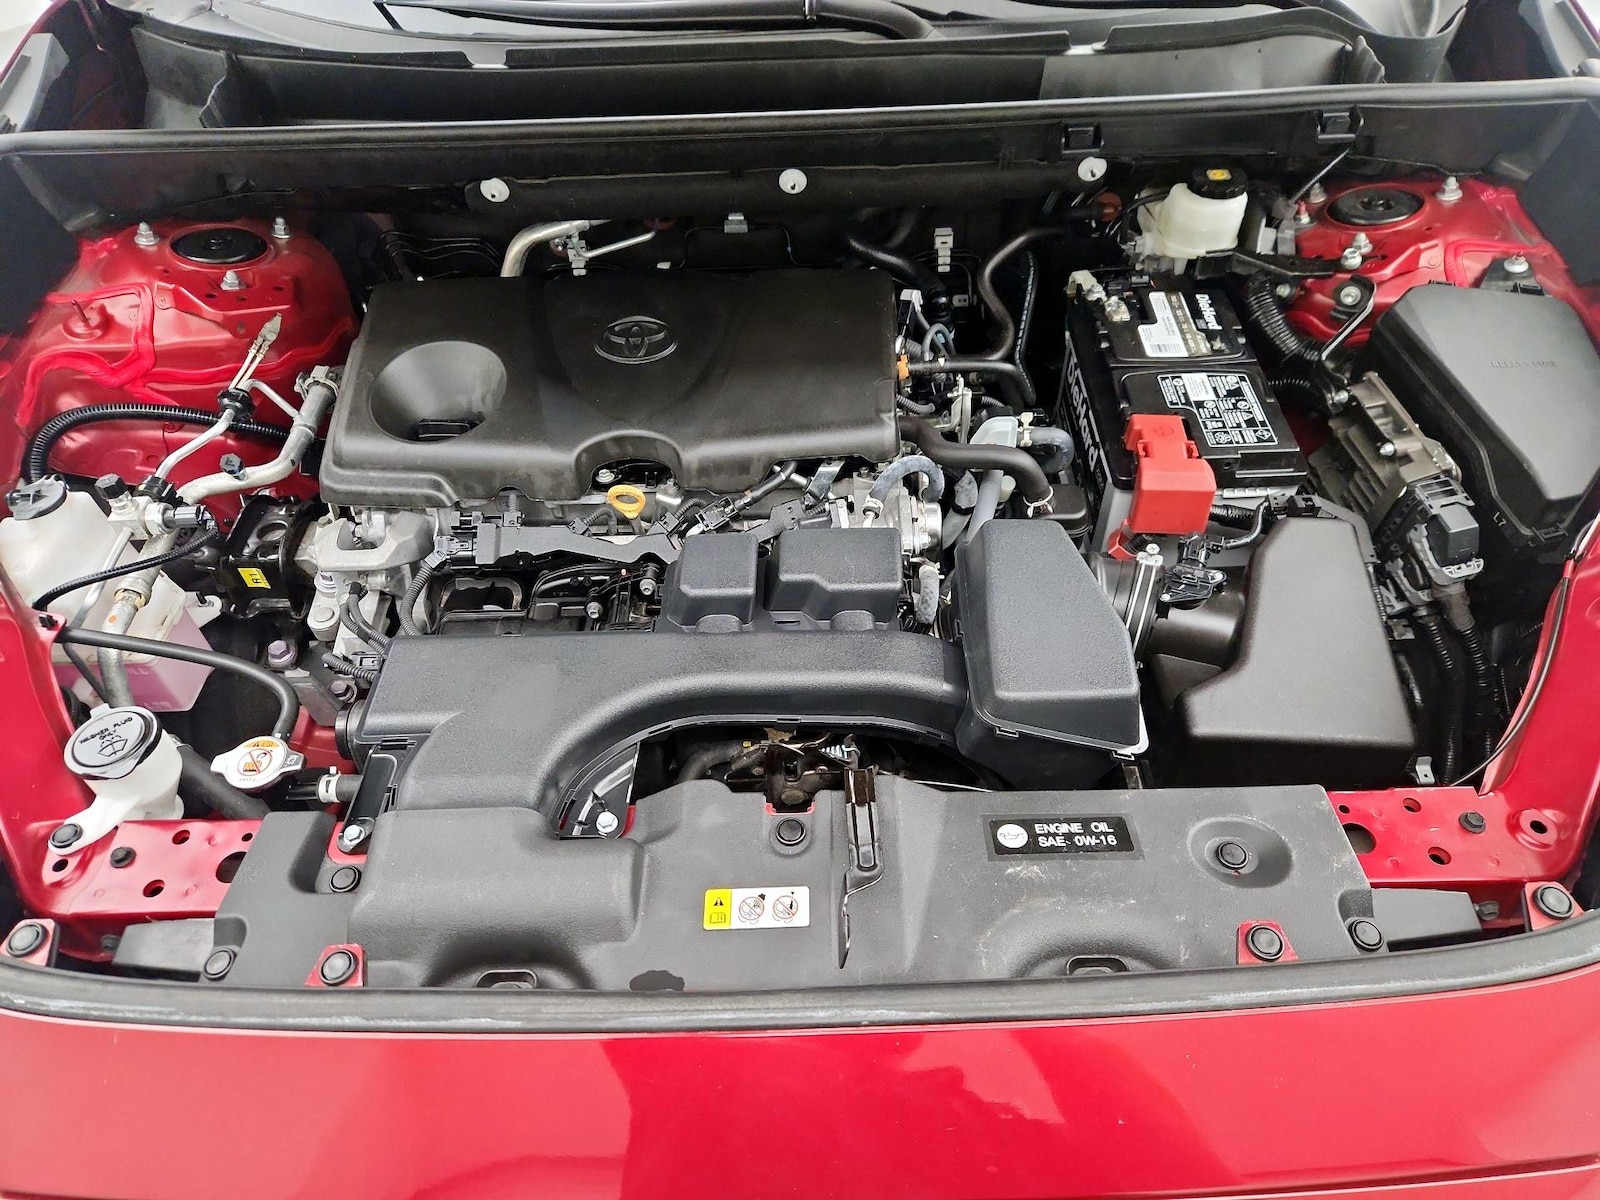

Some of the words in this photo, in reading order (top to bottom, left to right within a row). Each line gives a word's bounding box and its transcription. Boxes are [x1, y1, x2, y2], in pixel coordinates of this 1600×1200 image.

[1195, 293, 1223, 330] DieHard
[1067, 352, 1099, 473] DieHard
[1034, 822, 1084, 834] ENGINE
[1090, 821, 1114, 833] OIL
[1038, 835, 1067, 847] SAE
[1074, 834, 1117, 846] 0W-16
